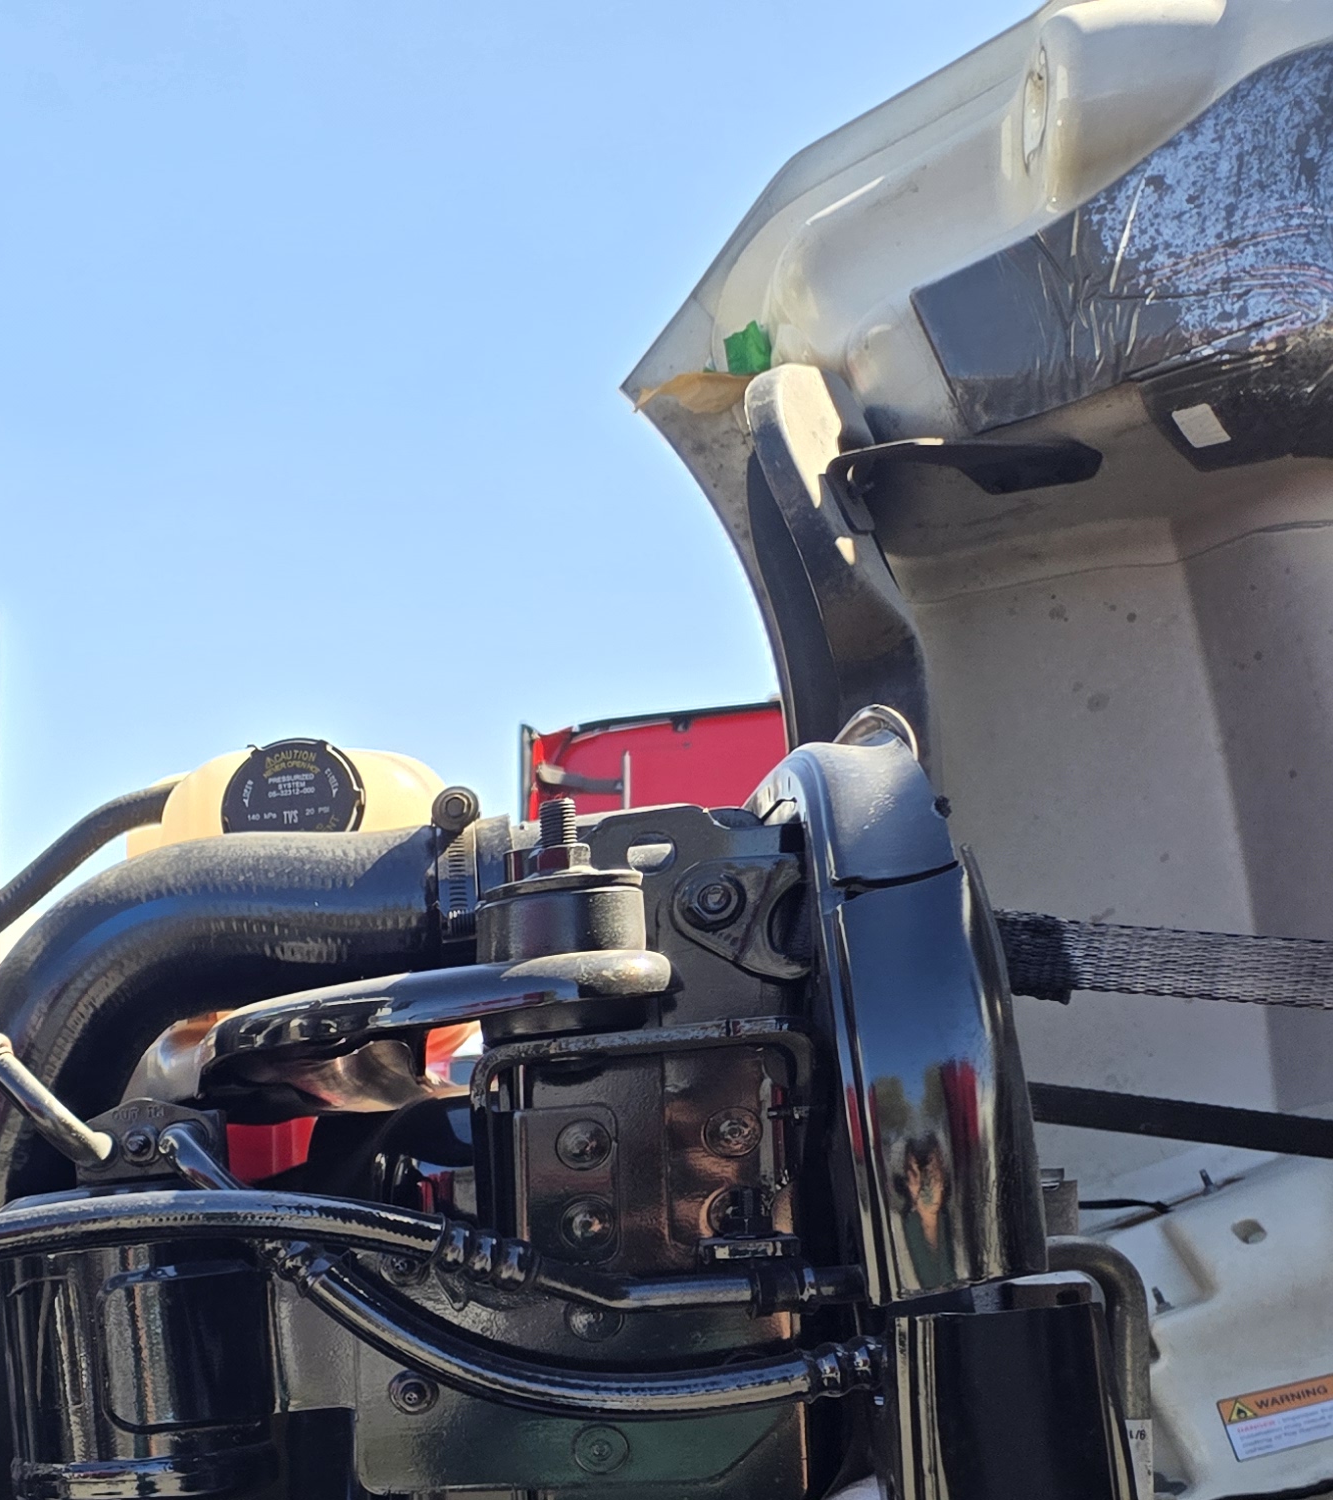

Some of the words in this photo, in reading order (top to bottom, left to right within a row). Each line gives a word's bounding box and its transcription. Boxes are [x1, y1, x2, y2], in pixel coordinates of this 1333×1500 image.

[274, 750, 317, 762] CAUTION
[283, 810, 299, 825] TVS
[305, 808, 315, 816] 20
[318, 806, 330, 814] PSI
[1255, 1384, 1328, 1410] WARNING
